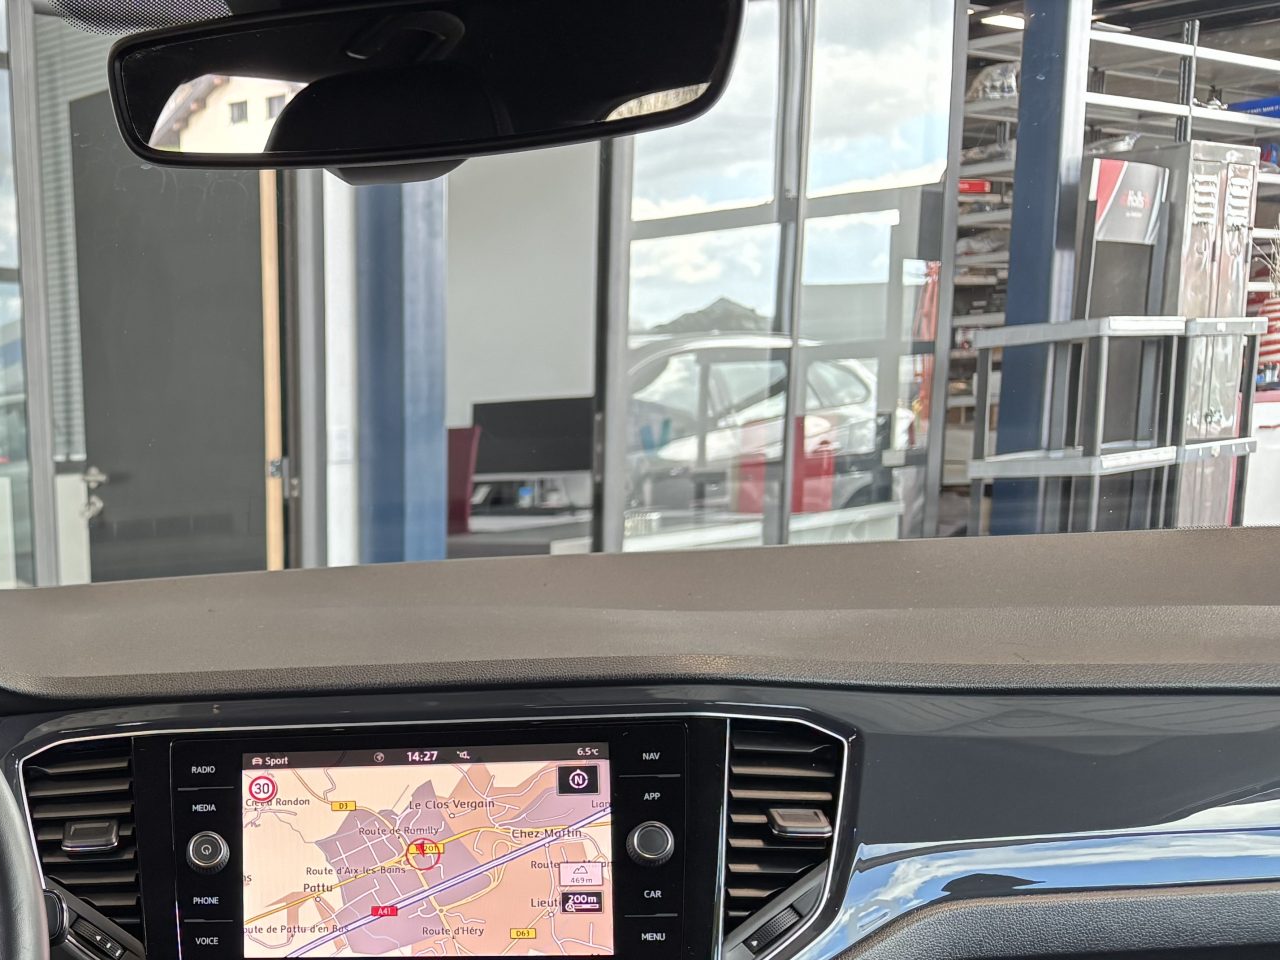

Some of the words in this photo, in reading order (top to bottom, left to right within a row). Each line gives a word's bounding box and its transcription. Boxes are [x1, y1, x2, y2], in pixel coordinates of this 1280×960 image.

[407, 751, 438, 762] 14:27
[642, 752, 660, 760] NAV
[265, 757, 289, 766] Sport
[191, 766, 216, 774] RADIO
[254, 782, 270, 795] 30
[643, 792, 661, 801] APP
[275, 798, 310, 806] Randon
[409, 801, 421, 810] Le
[425, 800, 449, 810] Clos
[452, 799, 495, 811] Vergain
[192, 804, 217, 812] MEDIA
[359, 827, 385, 835] Route
[389, 826, 400, 835] de
[511, 829, 540, 838] Chez
[531, 860, 560, 869] Route
[306, 867, 333, 875] Route
[304, 884, 333, 893] Pattu
[643, 890, 662, 899] CAR
[193, 896, 219, 905] PHONE
[377, 907, 391, 915] A41
[266, 925, 278, 934] de
[280, 924, 307, 933] Pattu
[422, 926, 451, 936] Route
[454, 926, 484, 937] d'Héry
[516, 929, 530, 938] D63
[195, 937, 219, 945] VOICE
[641, 933, 666, 941] MENU
